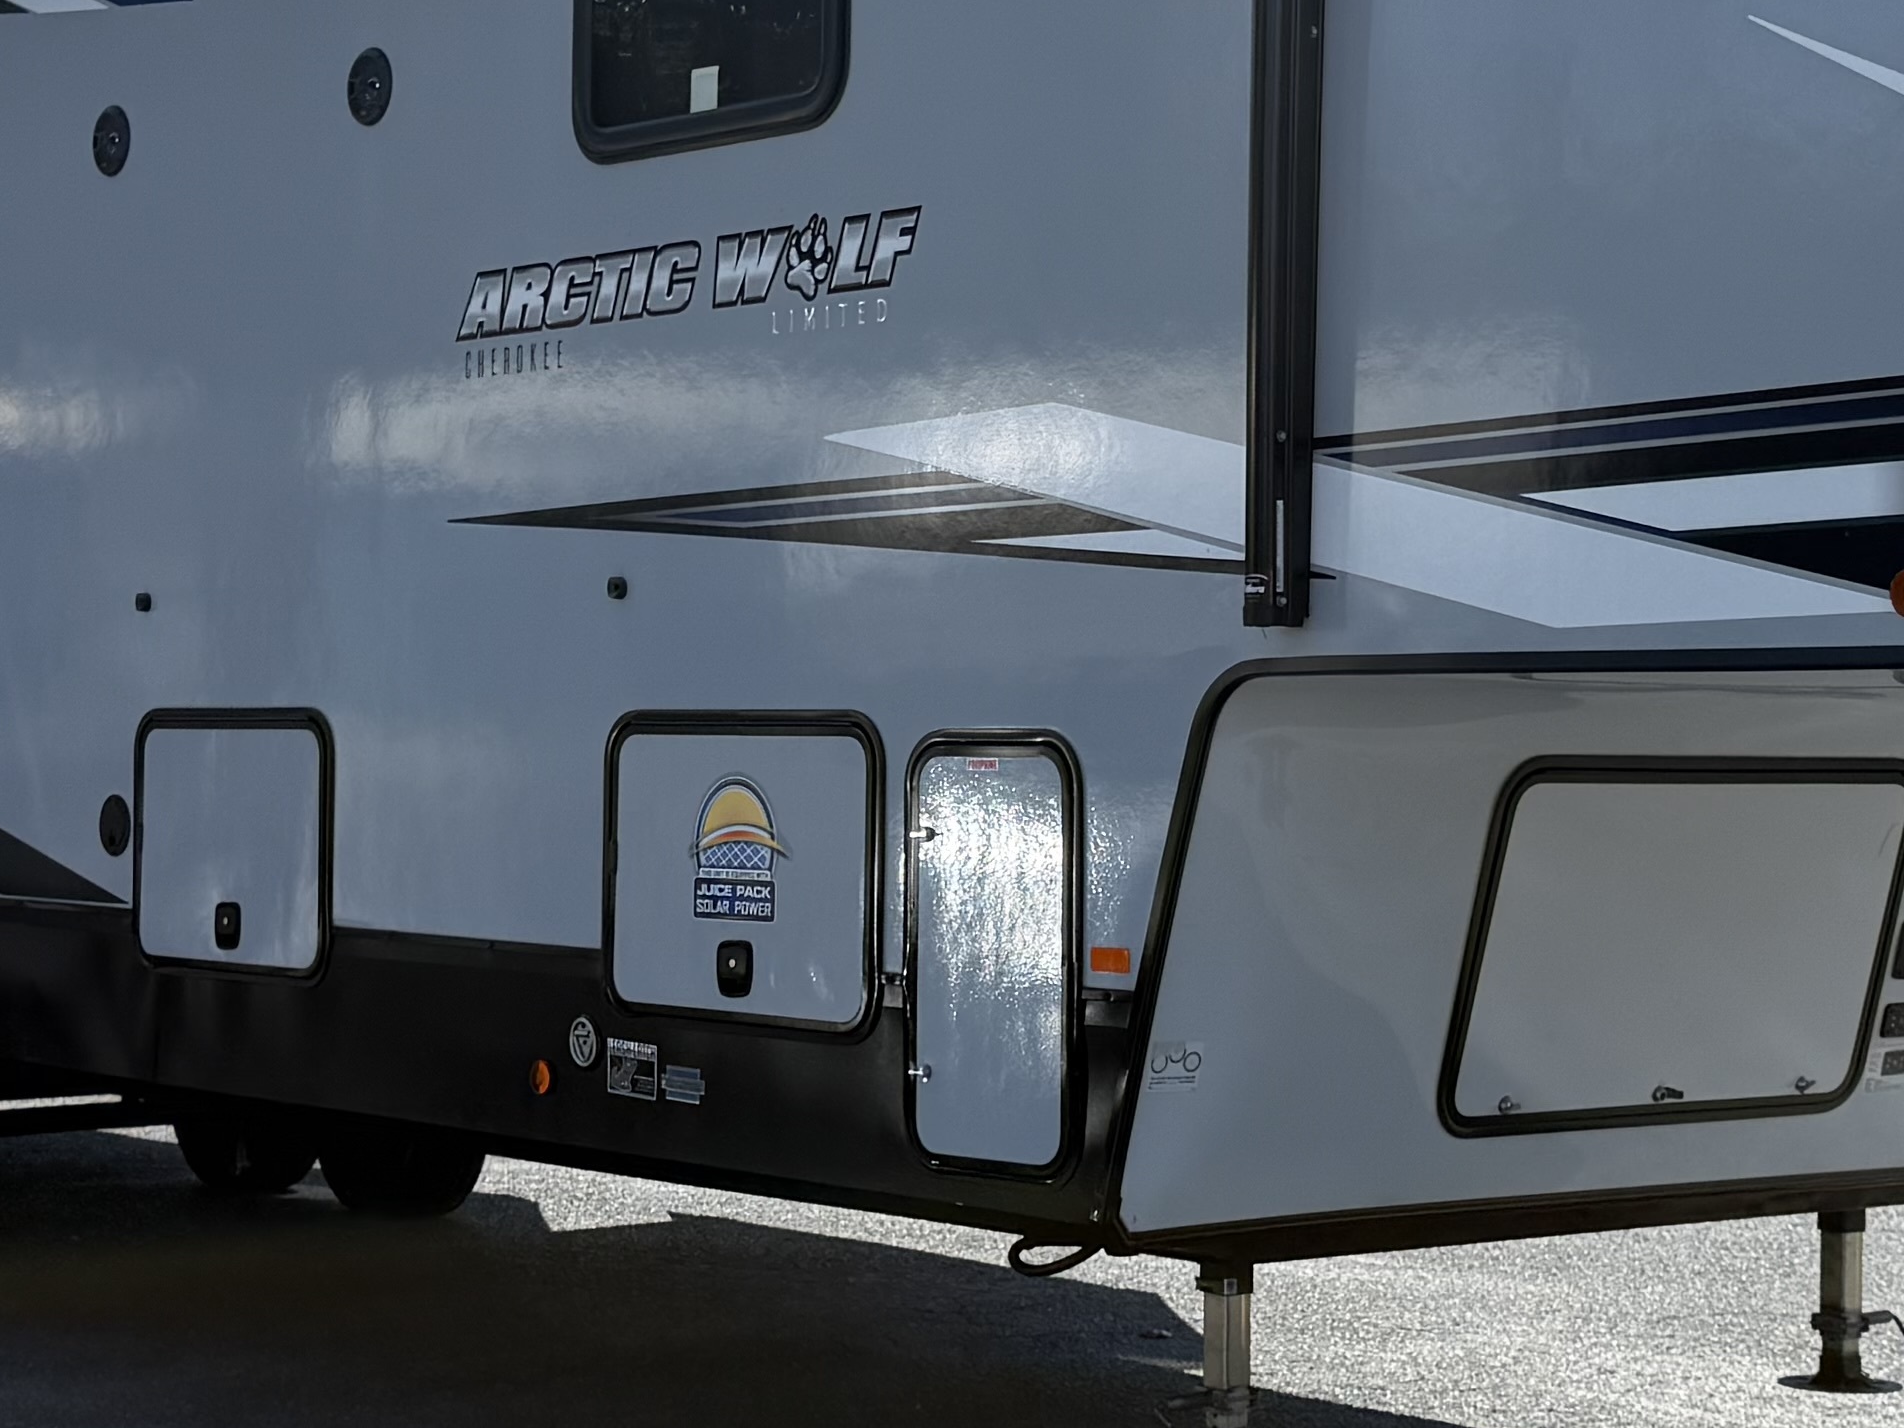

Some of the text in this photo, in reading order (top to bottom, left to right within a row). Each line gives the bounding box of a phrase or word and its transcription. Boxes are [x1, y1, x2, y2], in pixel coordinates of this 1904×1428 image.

[455, 240, 702, 342] ARCTIC
[771, 298, 888, 335] LIMITED
[464, 339, 564, 380] CHEROKEE
[696, 883, 771, 899] JUICE PACK
[696, 899, 772, 917] SOLAR POWER
